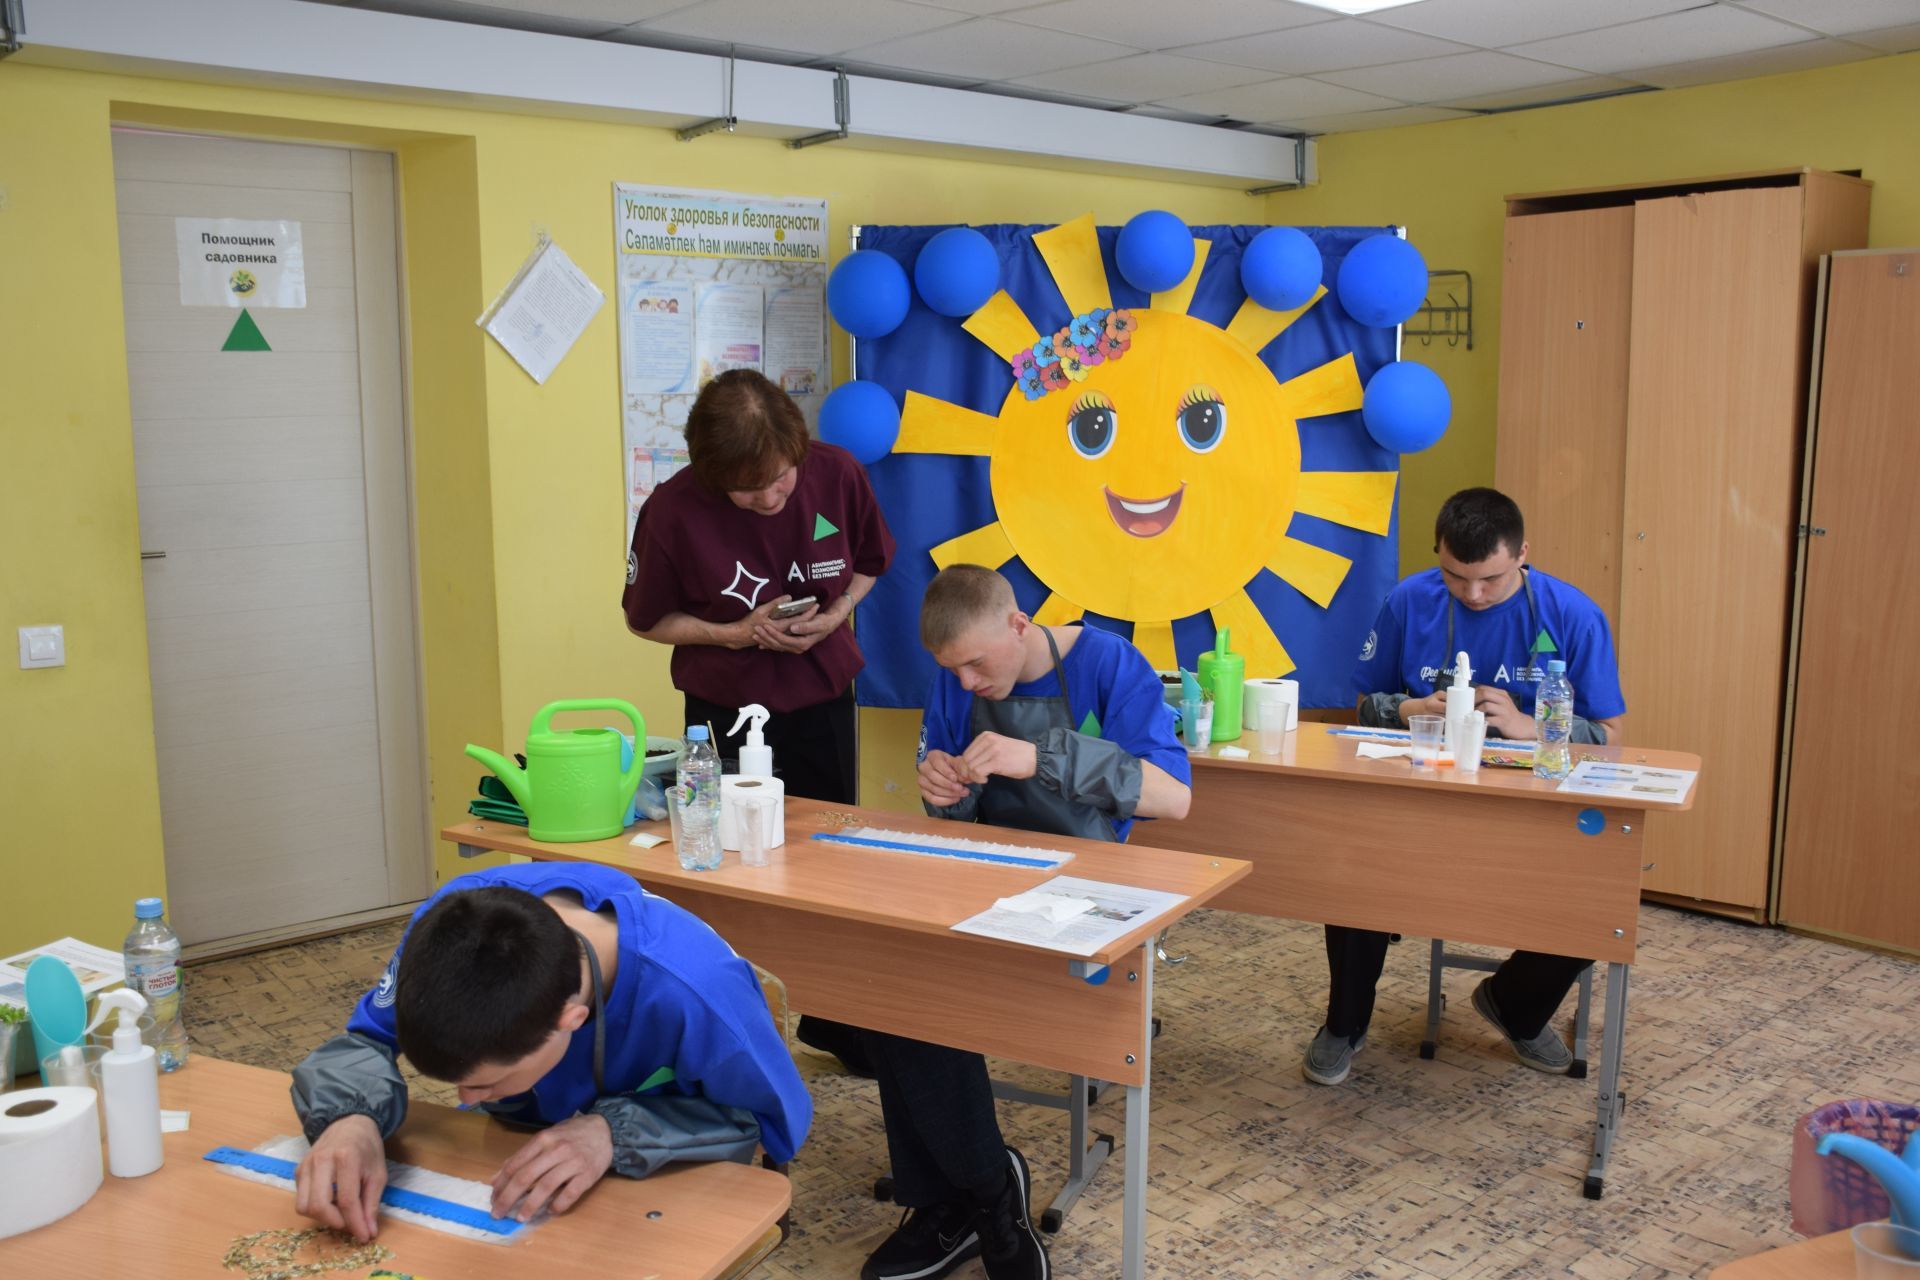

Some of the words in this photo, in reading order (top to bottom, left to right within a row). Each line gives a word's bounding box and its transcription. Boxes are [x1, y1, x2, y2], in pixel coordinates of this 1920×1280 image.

[625, 199, 667, 222] Уголок
[670, 207, 729, 229] здоровья
[732, 211, 739, 227] и
[742, 208, 820, 231] безопасности
[201, 232, 275, 247] Помощник
[724, 239, 771, 256] иминлек
[773, 242, 820, 259] почмагы
[205, 252, 277, 264] садовника
